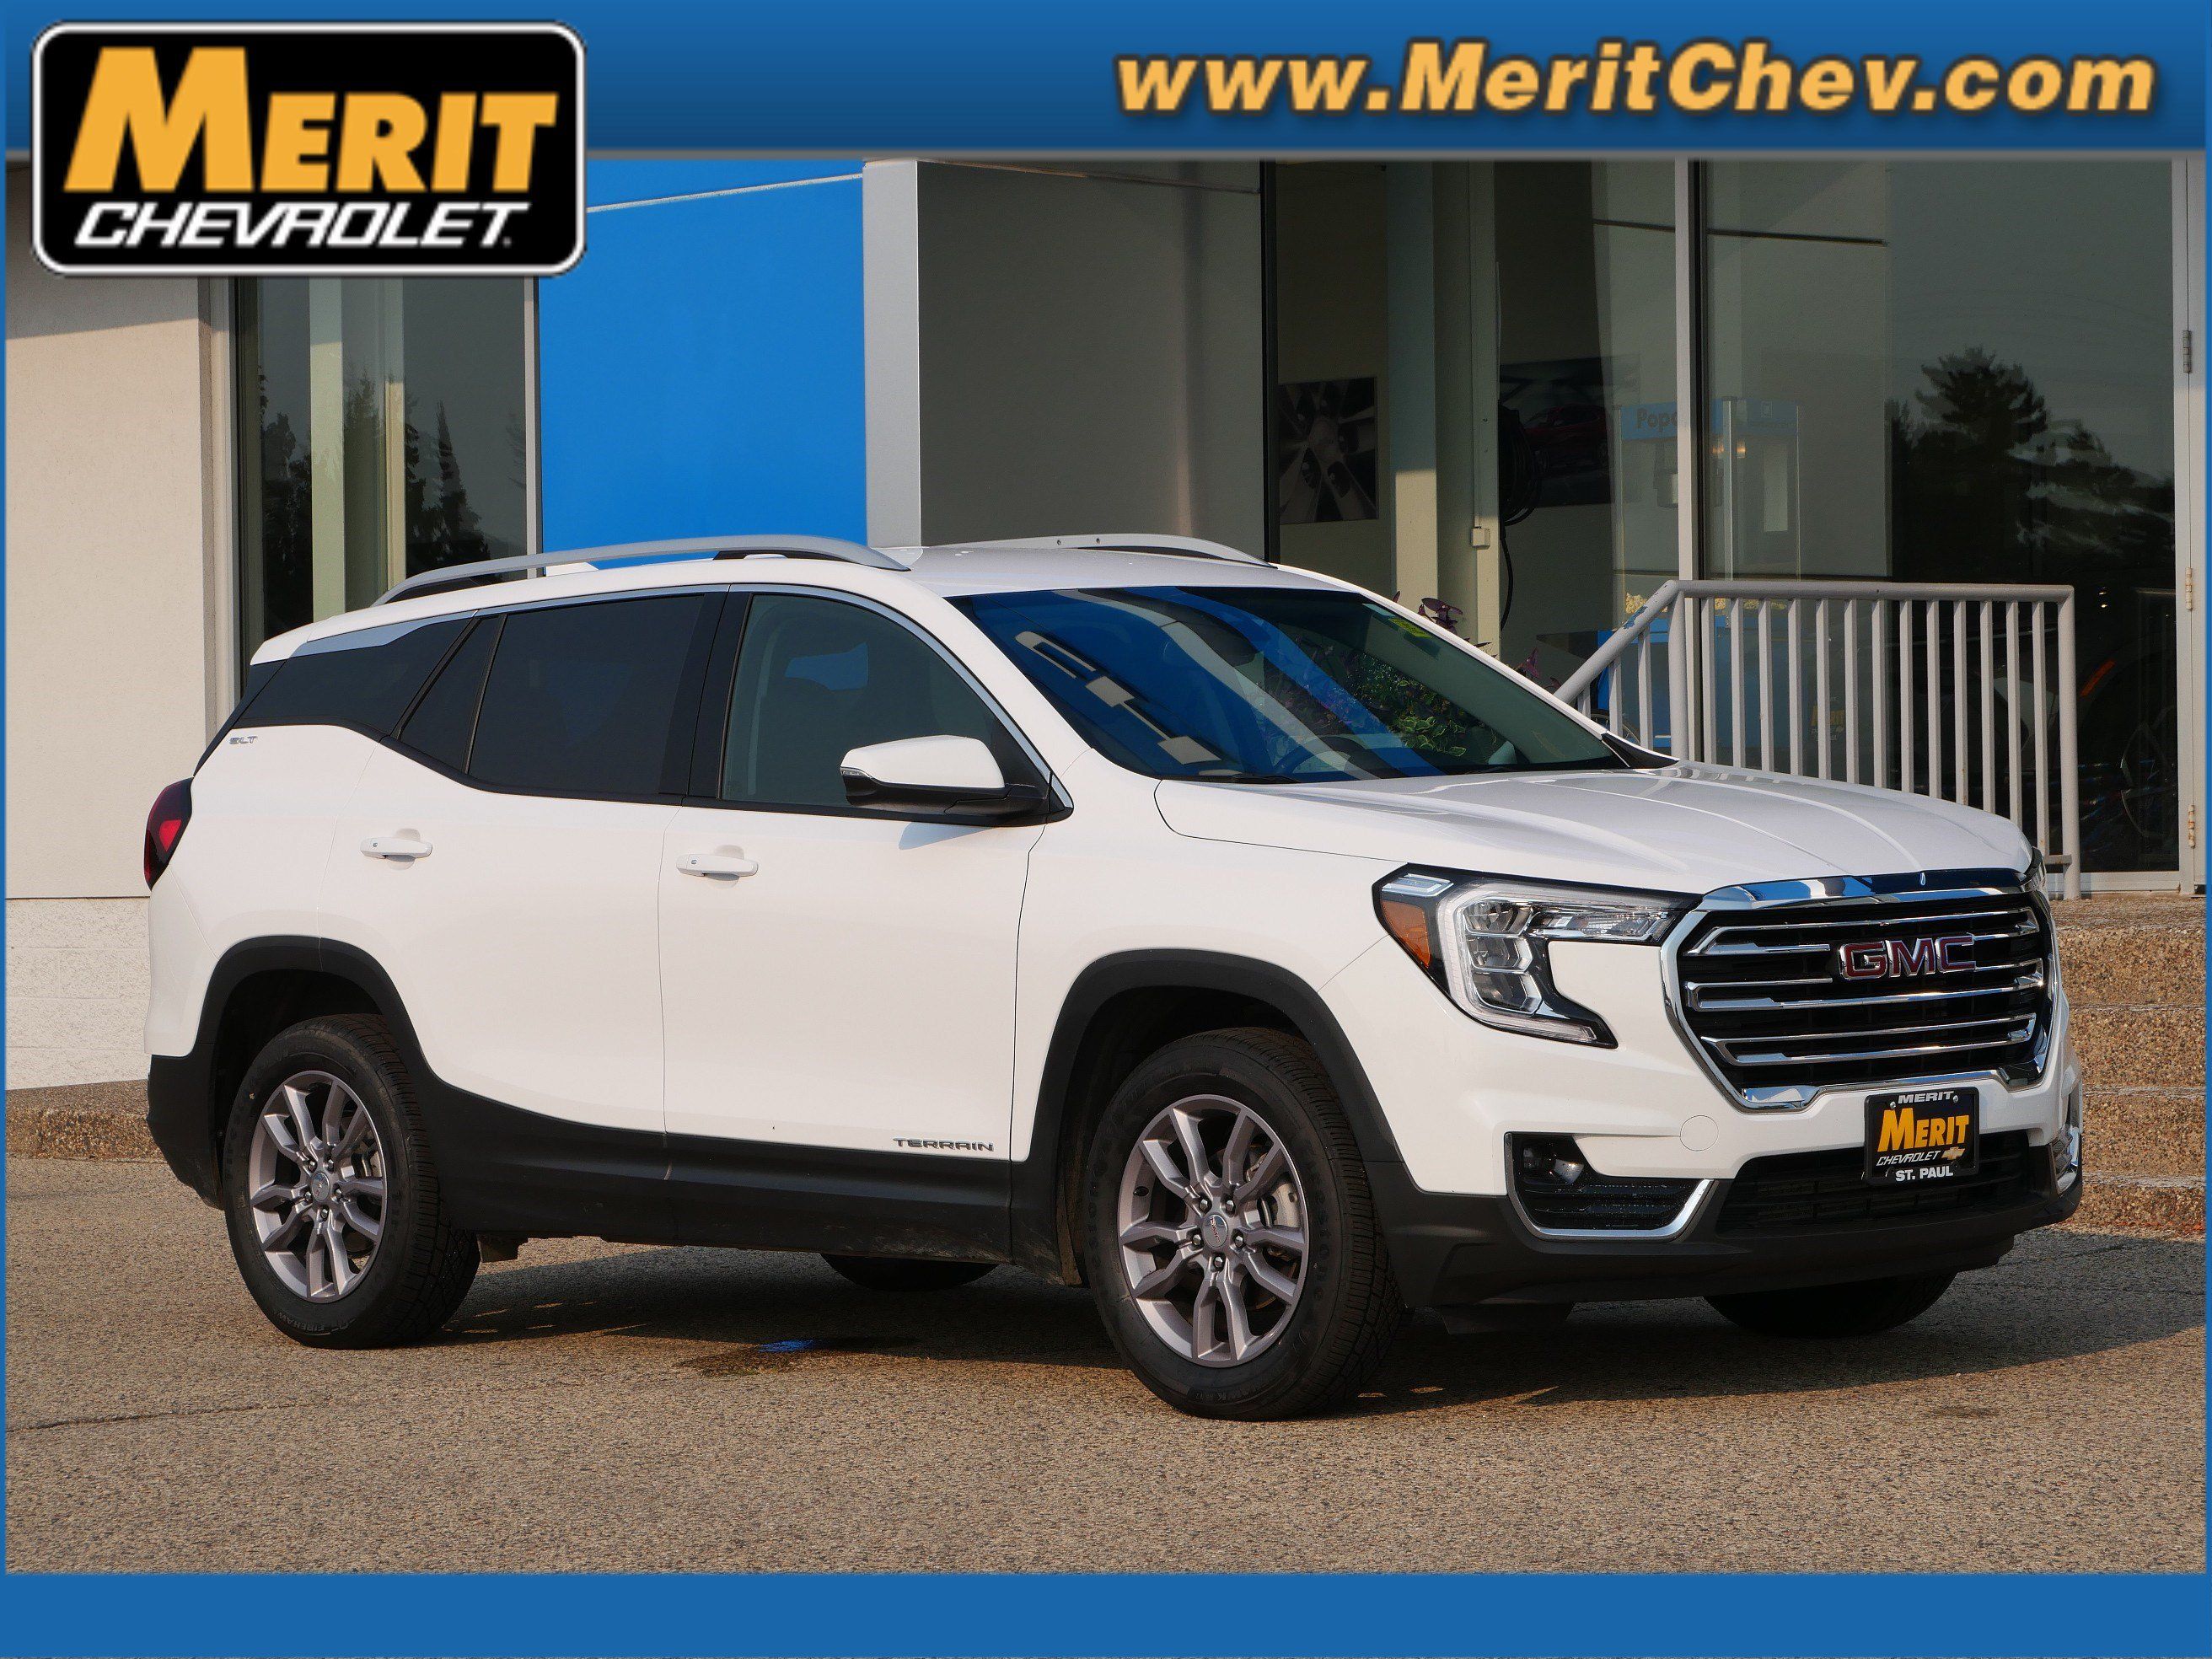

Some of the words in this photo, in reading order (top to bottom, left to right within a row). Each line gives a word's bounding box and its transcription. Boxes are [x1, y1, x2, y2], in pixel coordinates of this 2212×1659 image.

[1839, 932, 1977, 980] GMC
[1898, 1091, 1954, 1104] MERIT
[1877, 1107, 1969, 1152] MERIT
[893, 1138, 994, 1152] TERRAIN
[1876, 1150, 1941, 1167] CHEVROLET
[1895, 1168, 1915, 1182] ST.
[1919, 1165, 1954, 1178] PAUL
